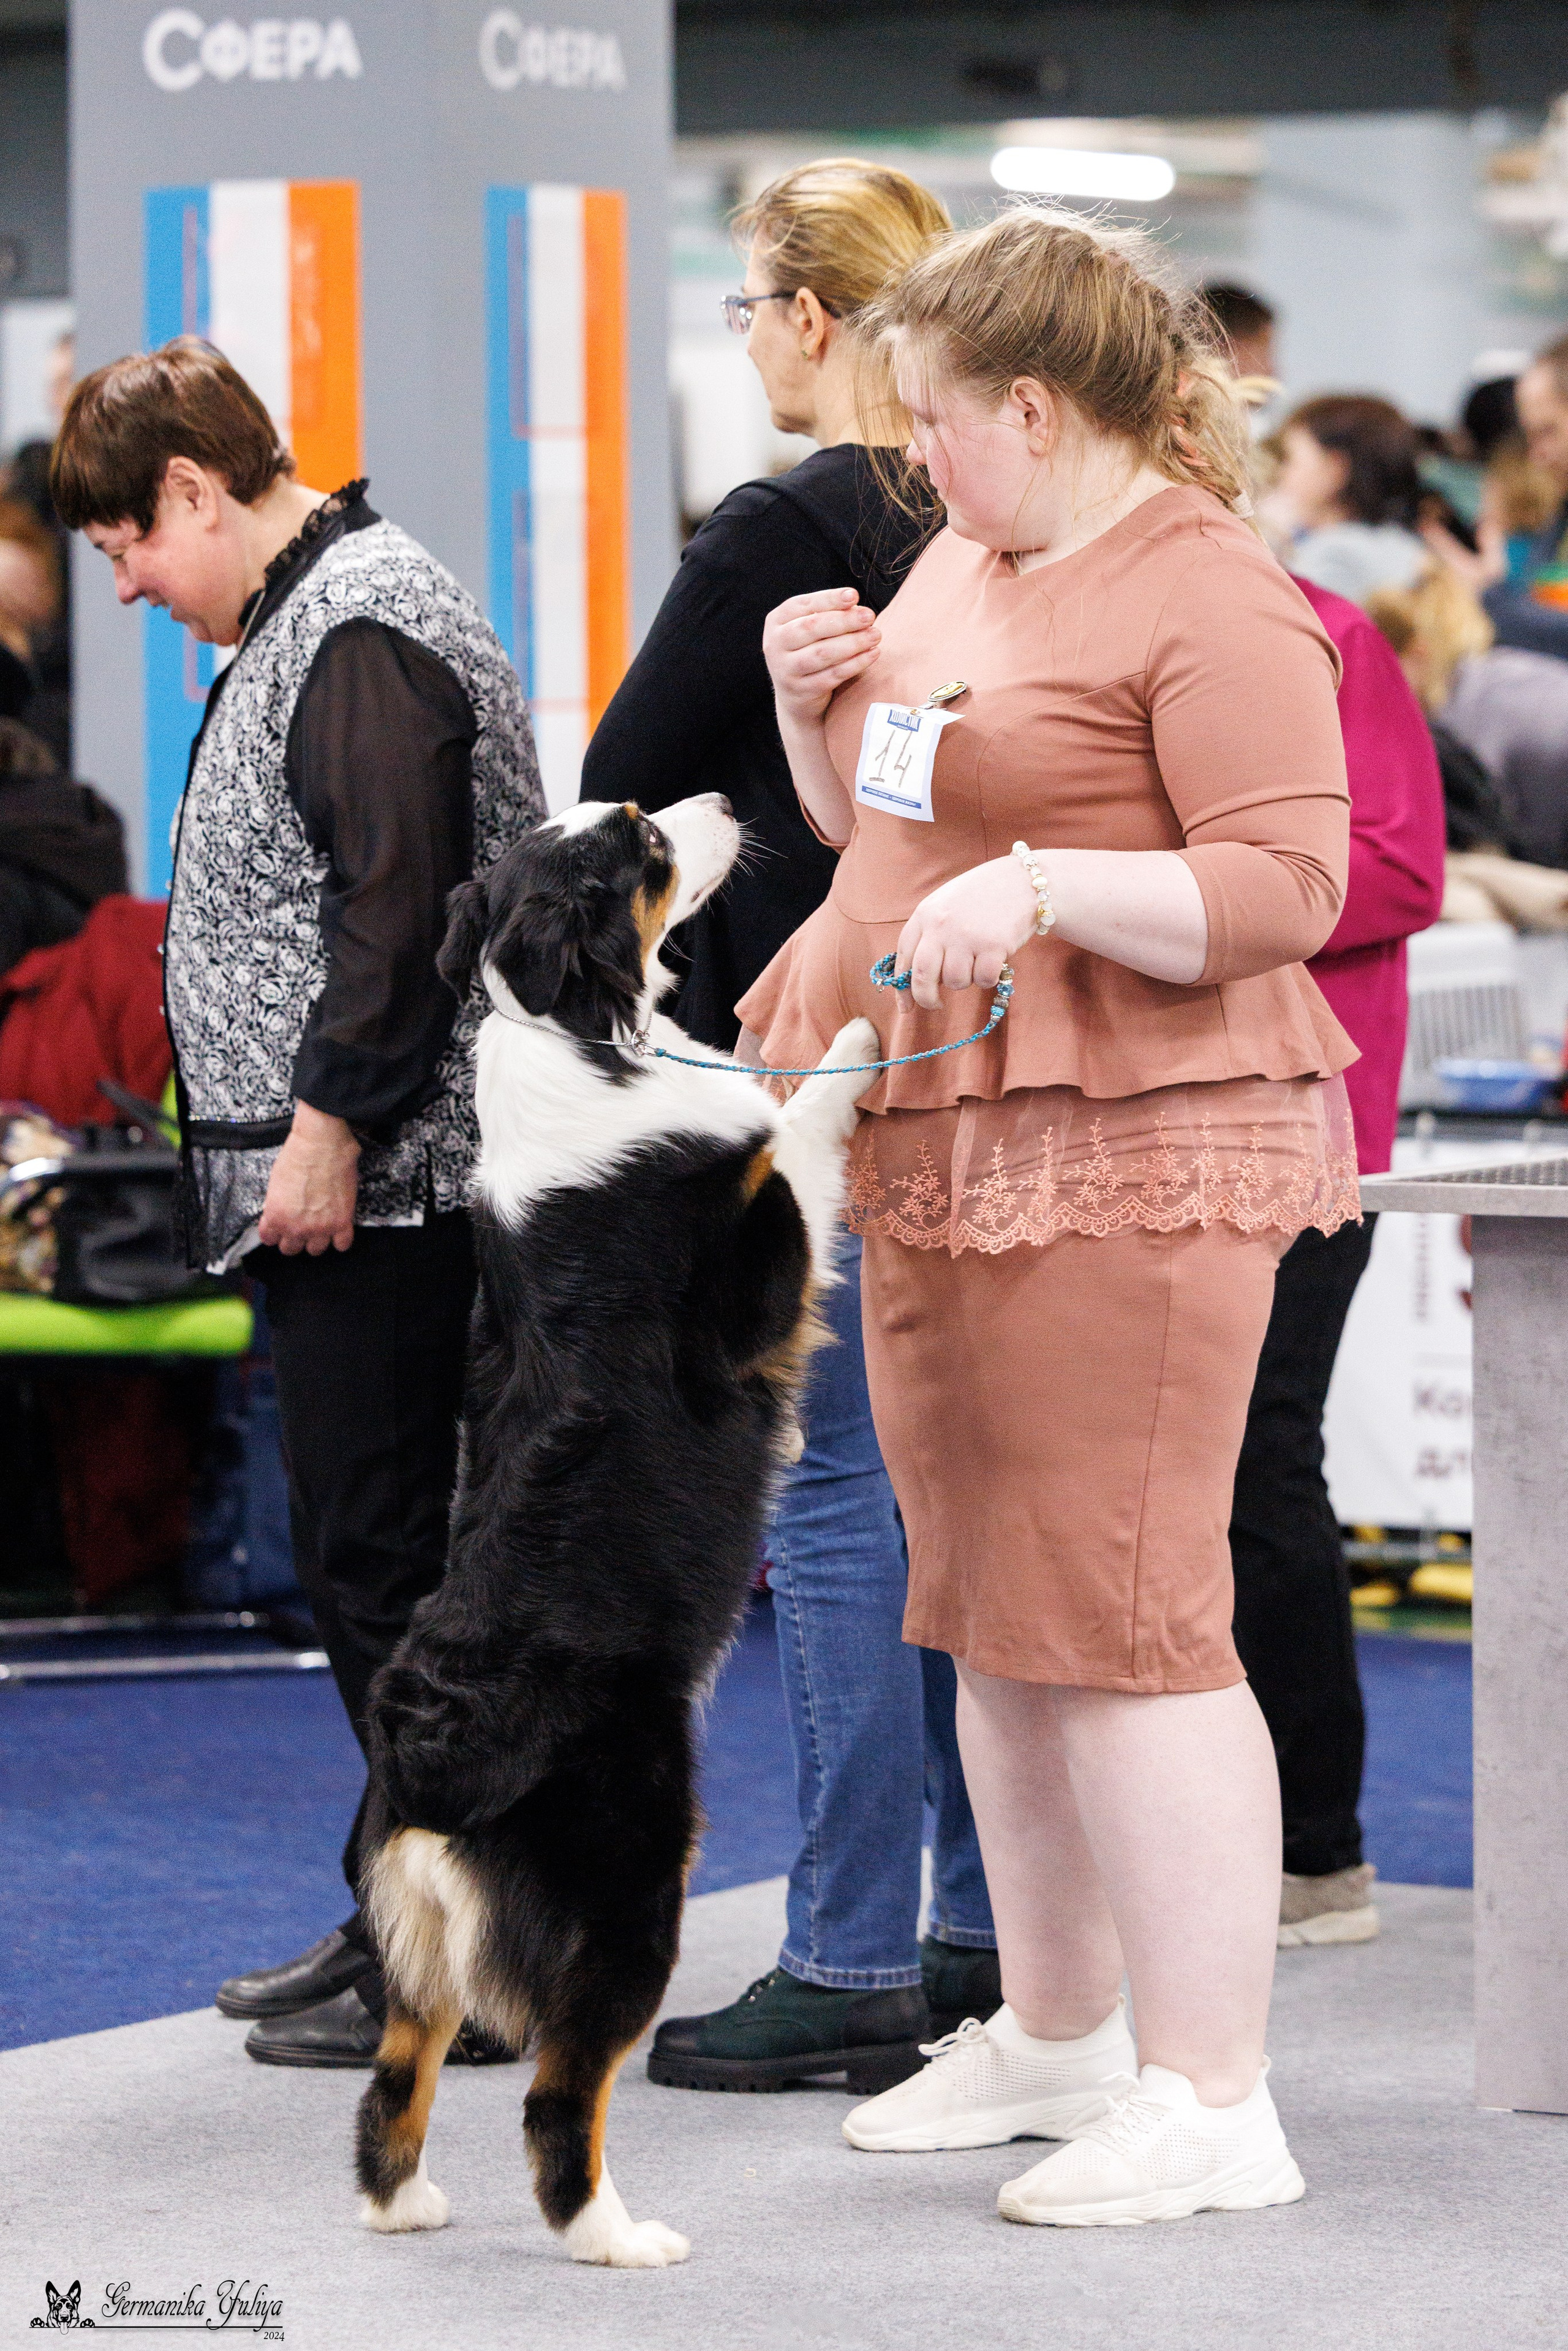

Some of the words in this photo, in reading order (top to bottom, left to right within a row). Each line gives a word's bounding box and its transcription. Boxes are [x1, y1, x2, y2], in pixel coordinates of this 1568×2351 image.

[143, 10, 362, 91] СФЕРА
[869, 730, 912, 788] 14
[1413, 1381, 1471, 1416] Ко
